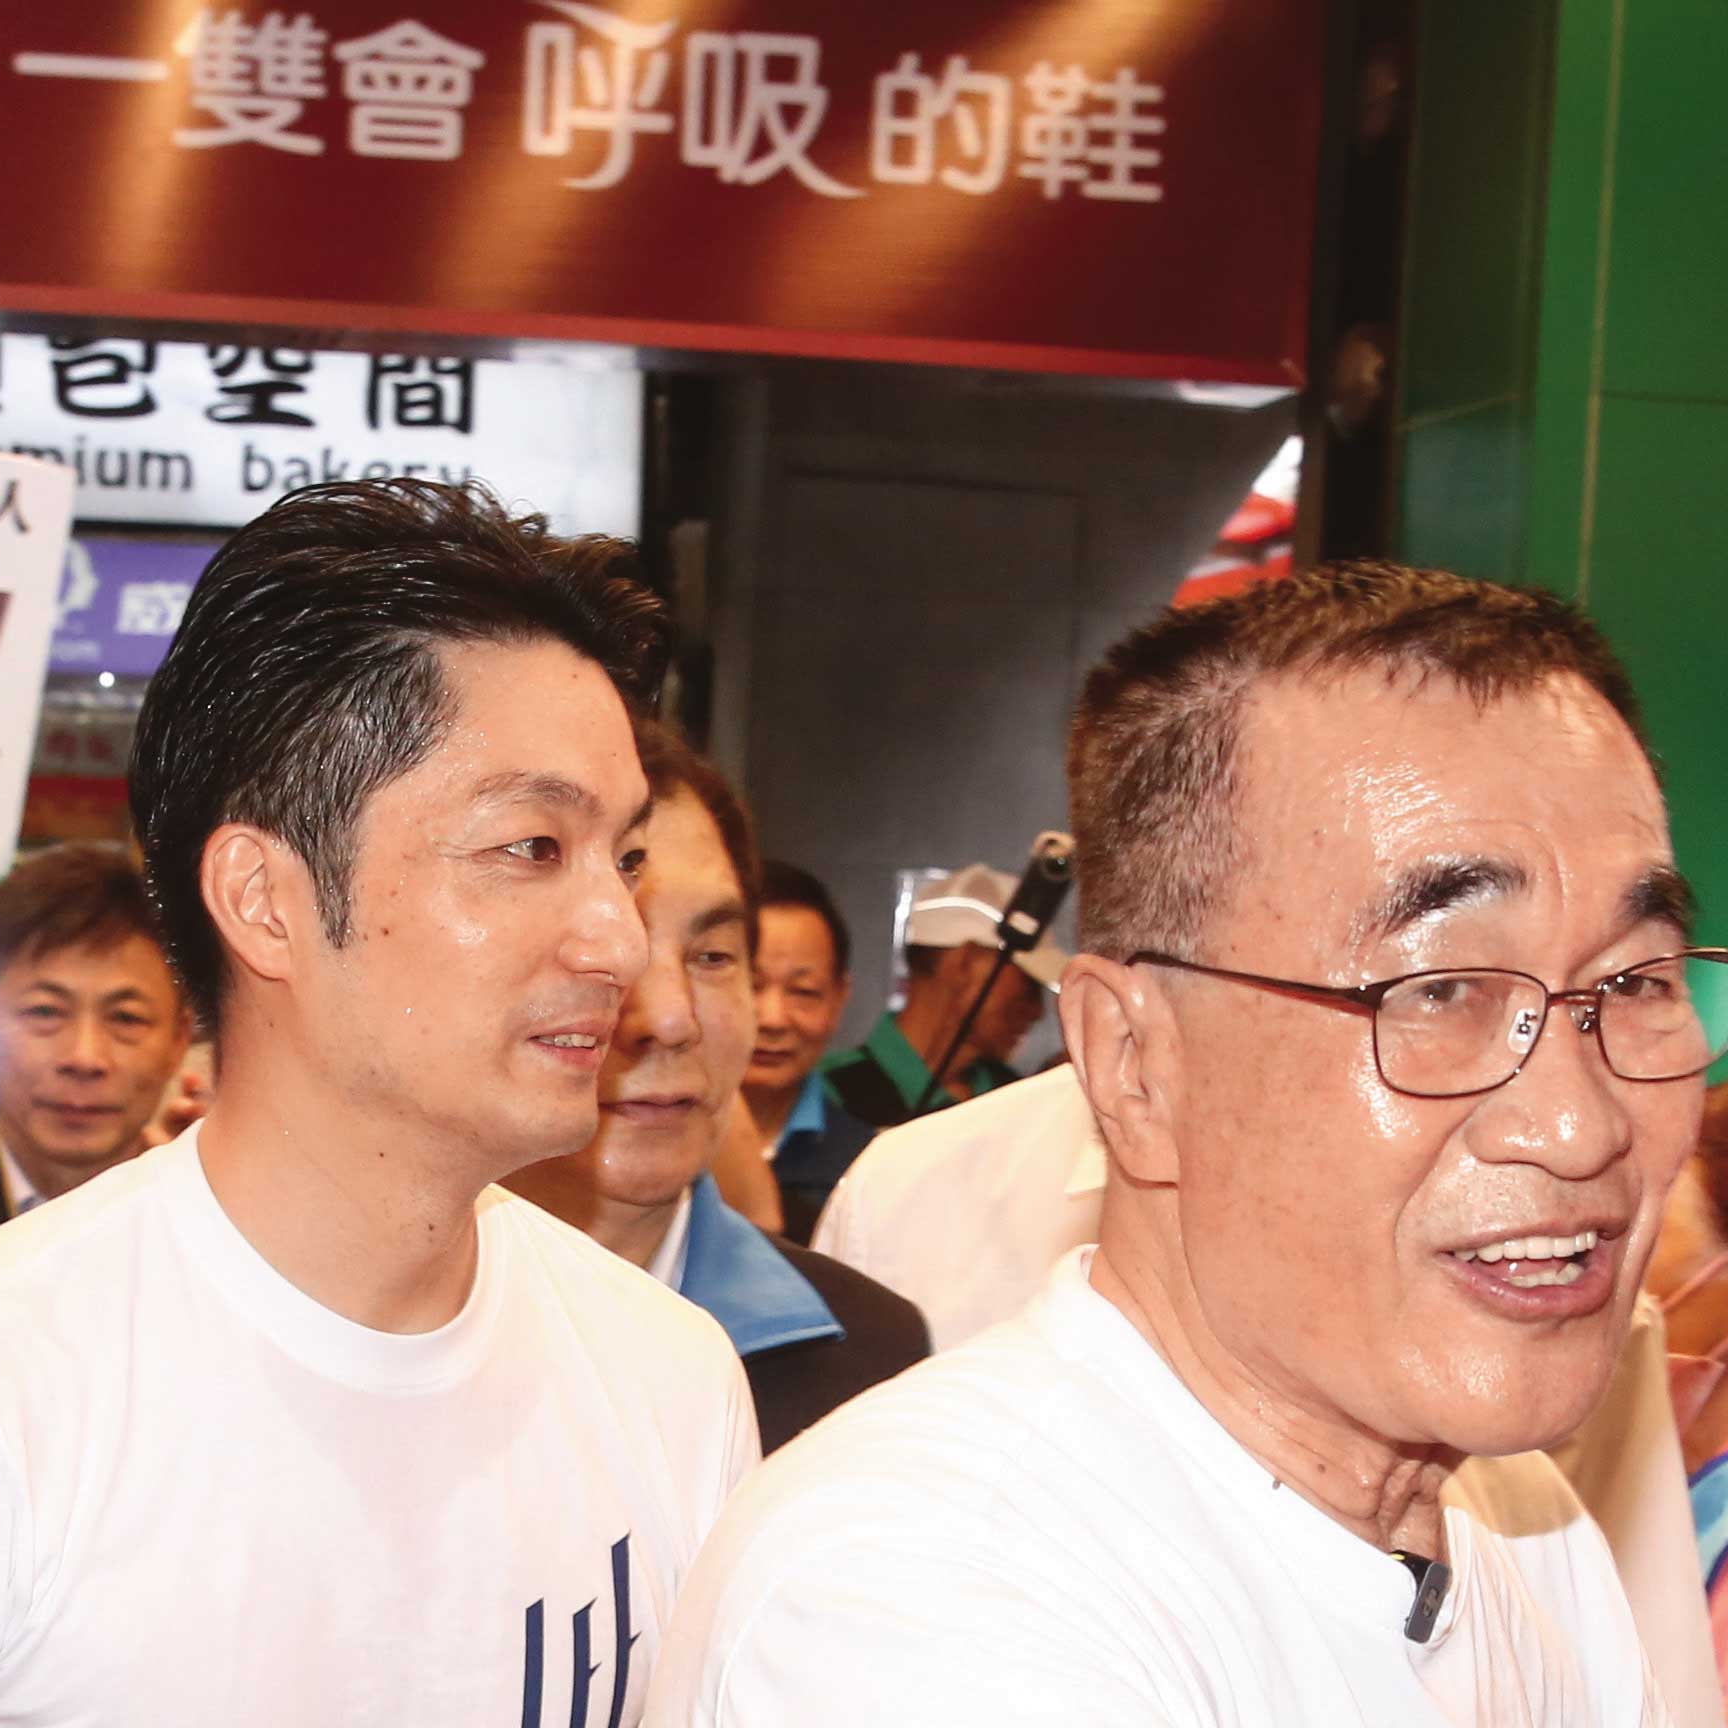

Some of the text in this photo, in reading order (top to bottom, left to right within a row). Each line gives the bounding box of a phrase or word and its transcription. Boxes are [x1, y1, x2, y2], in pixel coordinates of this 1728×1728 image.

[13, 0, 1165, 202] 一雙會呼吸的鞋
